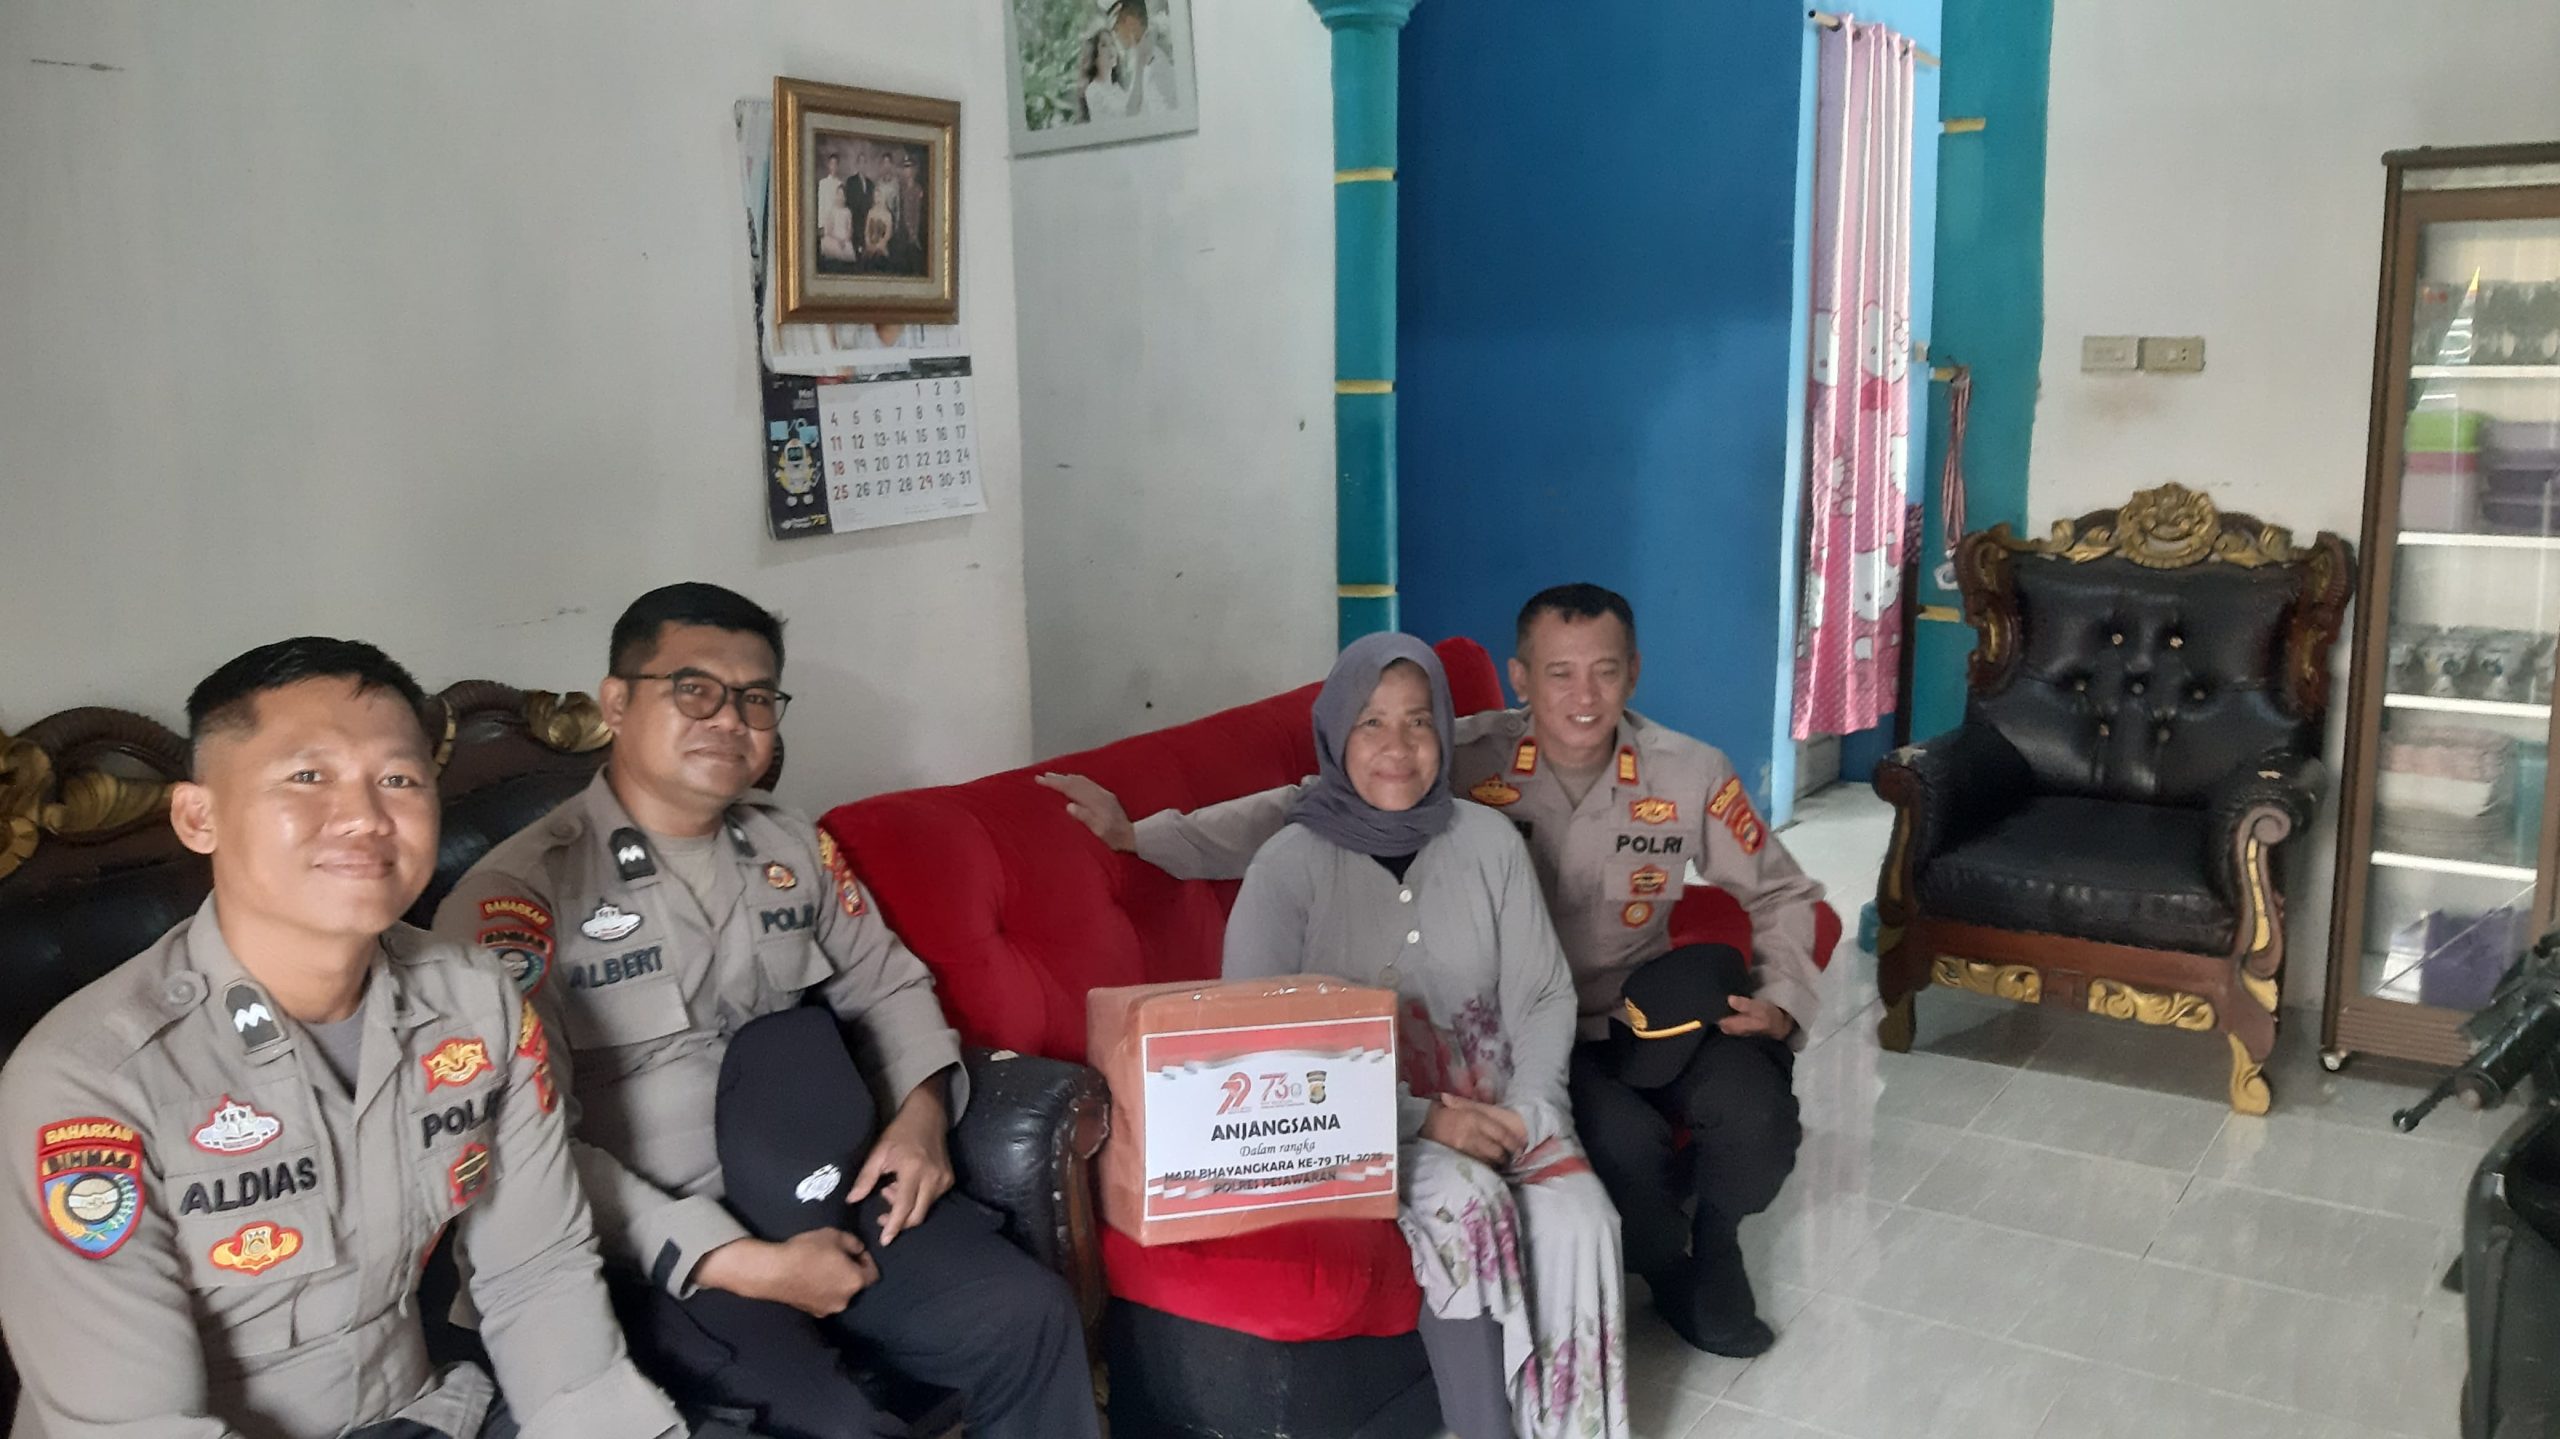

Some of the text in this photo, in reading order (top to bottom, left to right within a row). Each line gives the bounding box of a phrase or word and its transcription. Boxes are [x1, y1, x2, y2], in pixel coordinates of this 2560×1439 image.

[934, 381, 941, 396] 2
[954, 380, 961, 394] 3
[830, 402, 965, 427] 4 5 6 7 8 9 10
[830, 424, 966, 451] 11 12 13 14 15 16 17
[832, 447, 970, 476] 18 19 20 21 22 23 24
[834, 484, 849, 500] 25
[856, 482, 870, 497] 26
[877, 480, 891, 495] 27
[898, 477, 912, 493] 28
[918, 475, 933, 490] 29
[959, 470, 971, 485] 31
[1615, 835, 1683, 854] POLRI
[760, 902, 815, 934] POLR
[570, 946, 662, 989] ALBERT
[421, 1087, 504, 1149] POL
[1211, 1114, 1341, 1141] ANJANGSANA
[1240, 1140, 1316, 1156] Dalam rangka
[1165, 1169, 1196, 1181] HARI
[1199, 1161, 1294, 1179] BHAYANGKARA
[1298, 1157, 1332, 1168] KE-79
[1213, 1170, 1337, 1193] POLRES PESAWARAN
[180, 1156, 317, 1216] ALDIAS
